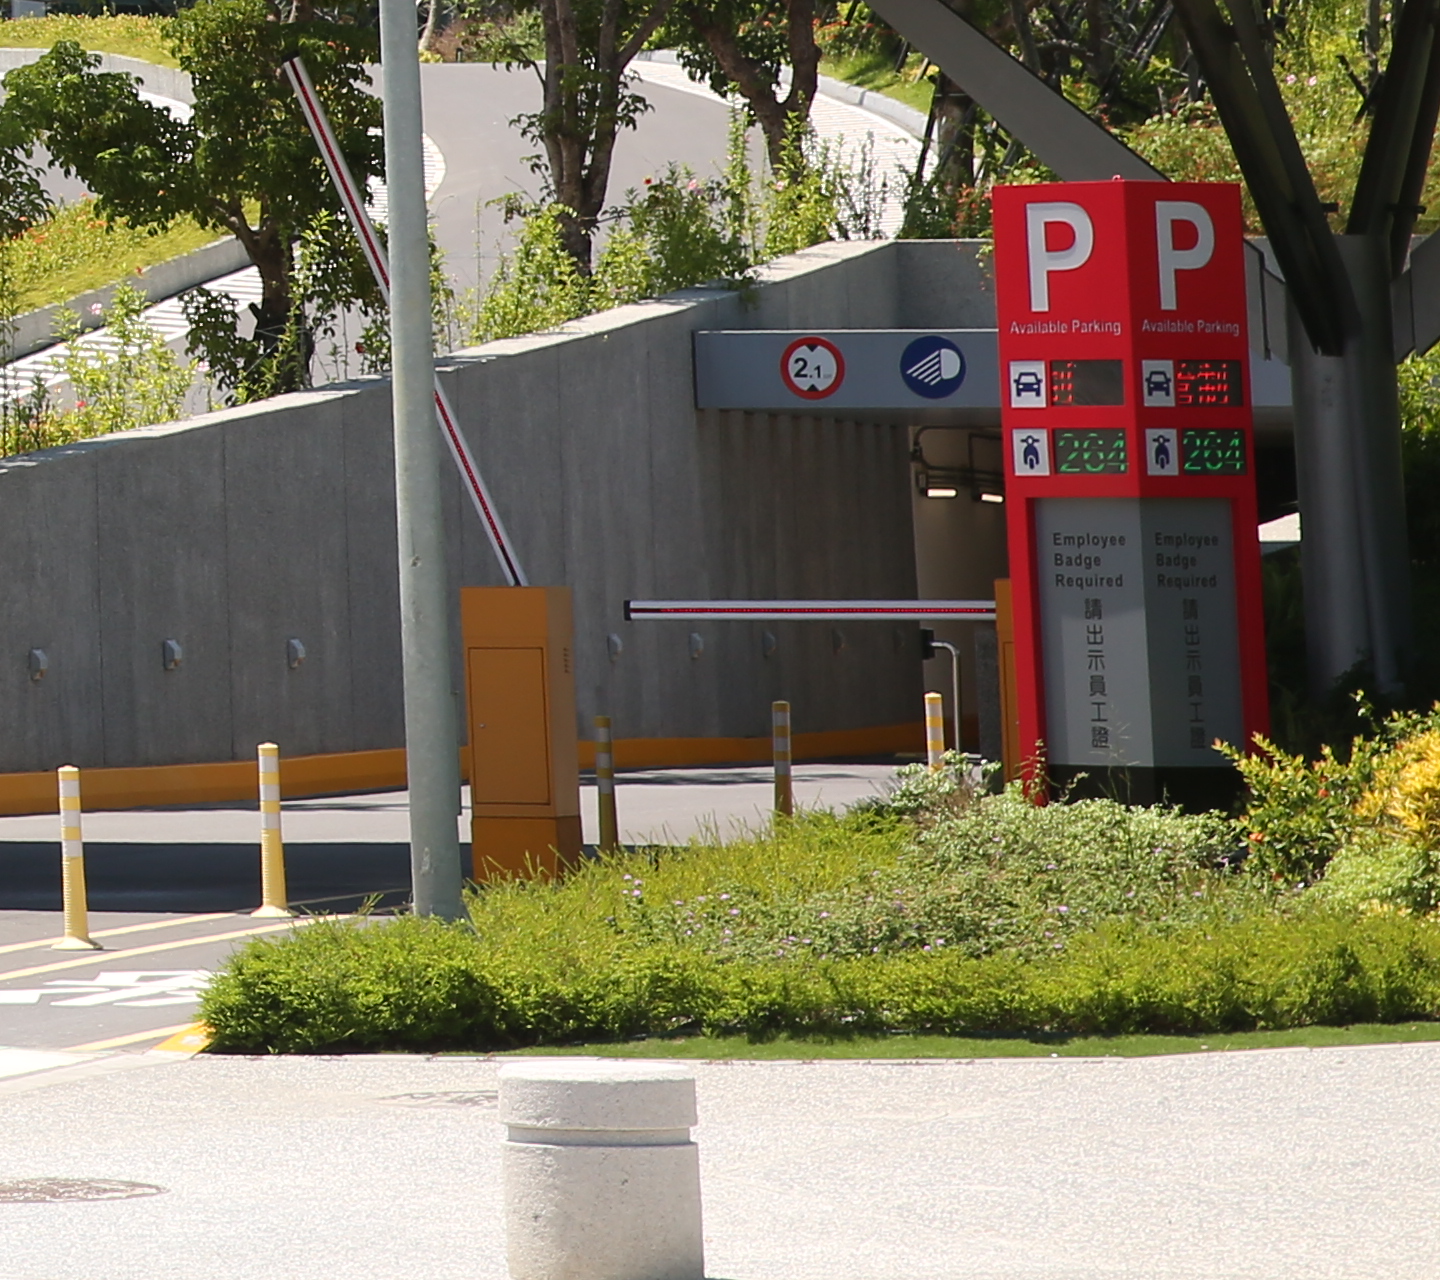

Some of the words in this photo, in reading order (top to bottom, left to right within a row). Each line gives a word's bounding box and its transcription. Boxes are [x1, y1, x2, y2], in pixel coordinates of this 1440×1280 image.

[1025, 201, 1094, 313] P
[1154, 200, 1215, 311] P
[1010, 320, 1068, 335] Available
[1072, 319, 1122, 336] Parking
[1142, 319, 1194, 333] Available
[1197, 319, 1240, 336] Parking
[793, 357, 821, 379] 2.1
[1058, 433, 1129, 472] 264
[1183, 431, 1244, 471] 264
[1052, 532, 1127, 549] Employee
[1154, 532, 1219, 549] Employee
[1054, 553, 1102, 570] Badge
[1156, 553, 1197, 570] Badge
[1055, 573, 1124, 590] Required
[1157, 573, 1218, 590] Required
